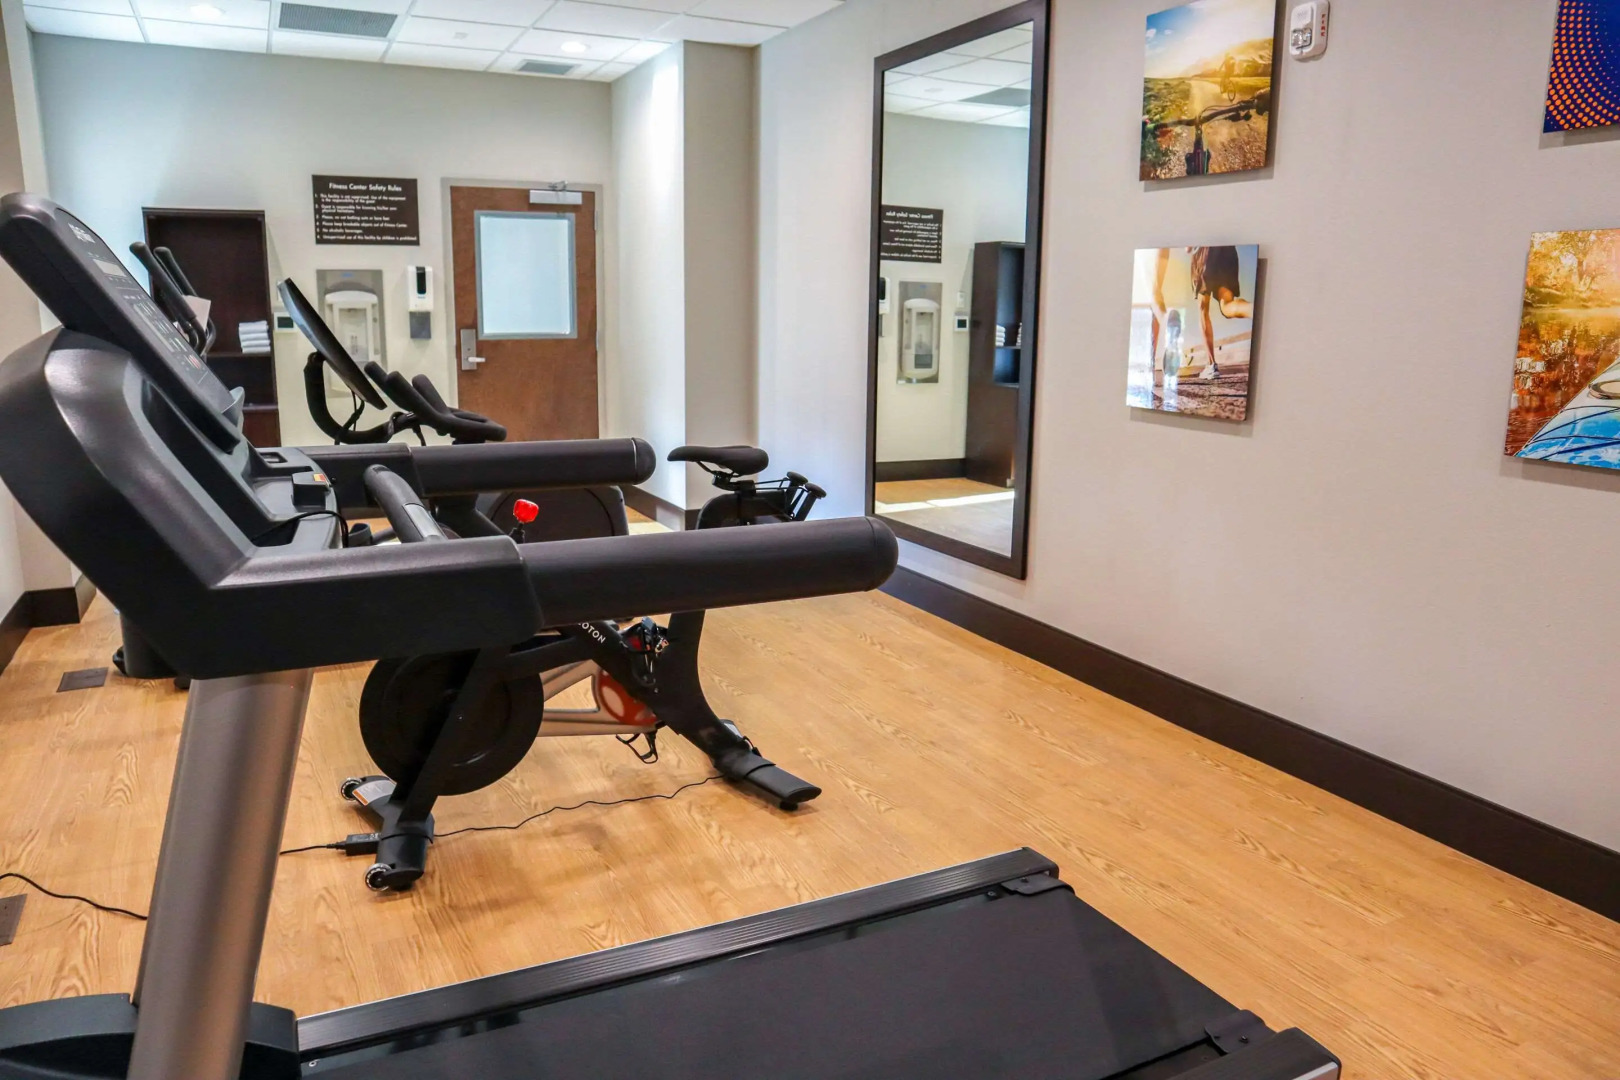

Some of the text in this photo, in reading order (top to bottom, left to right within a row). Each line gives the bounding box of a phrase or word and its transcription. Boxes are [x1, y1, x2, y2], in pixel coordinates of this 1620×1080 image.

[328, 182, 348, 190] Fitness
[368, 184, 386, 192] Safety
[578, 622, 606, 644] OTON
